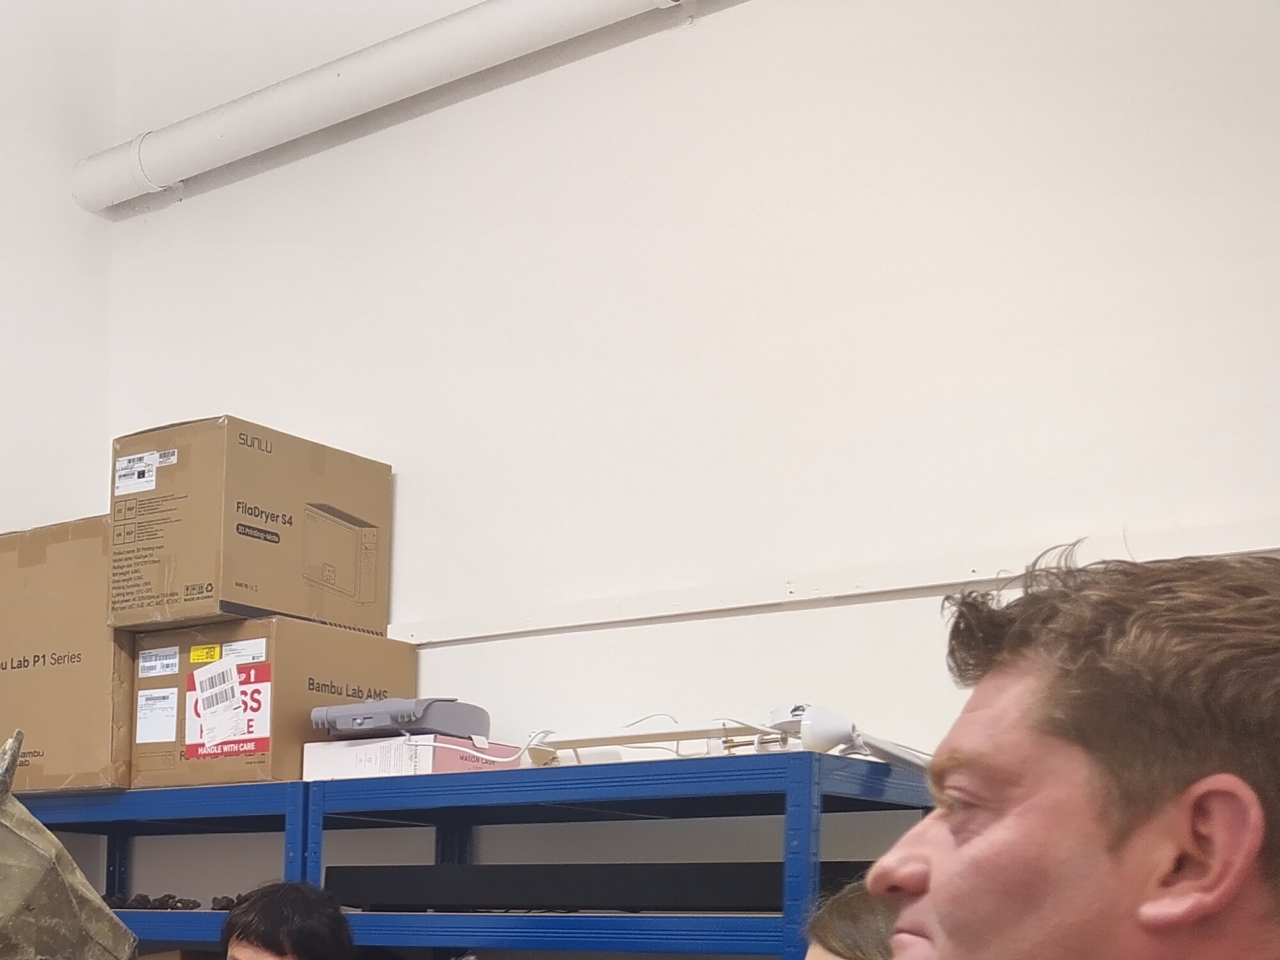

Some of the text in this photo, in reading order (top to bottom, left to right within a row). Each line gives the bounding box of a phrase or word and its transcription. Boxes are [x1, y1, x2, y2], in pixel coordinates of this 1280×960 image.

[238, 433, 273, 454] SUNLU
[236, 501, 294, 527] FilaDryer S4
[10, 655, 30, 670] Lab
[32, 653, 46, 668] P1
[49, 651, 82, 666] Series
[308, 676, 389, 702] Bambu Lab AMS
[19, 749, 45, 759] ambu
[197, 741, 256, 755] HANDLE WITH CARE
[17, 758, 30, 768] ab
[459, 754, 480, 763] MASON
